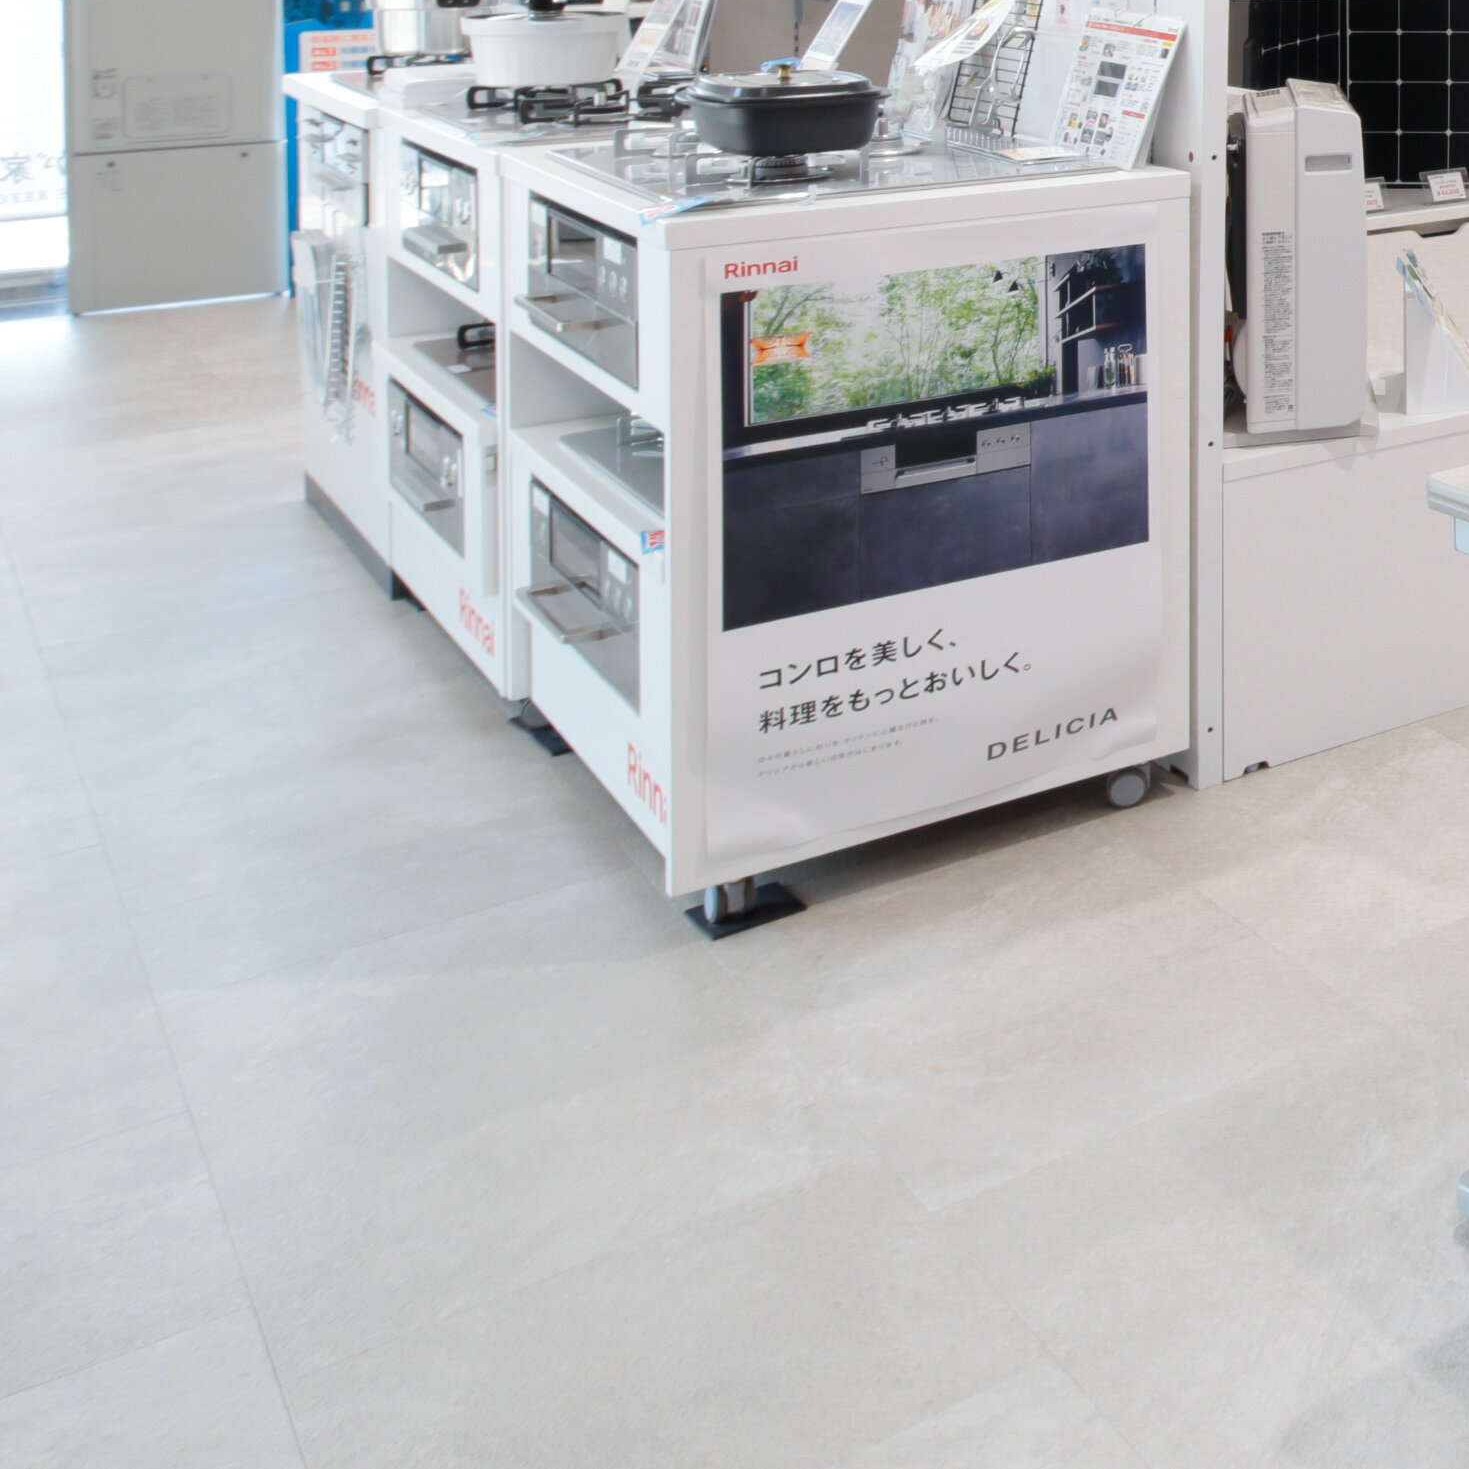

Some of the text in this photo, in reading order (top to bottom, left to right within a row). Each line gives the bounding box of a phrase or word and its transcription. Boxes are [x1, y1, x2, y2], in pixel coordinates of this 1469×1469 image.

[723, 255, 799, 280] Rinnai
[759, 628, 958, 691] コンロを美しく、
[759, 651, 1033, 735] 料理をもっとおいしく。
[986, 706, 1120, 762] DELICIA
